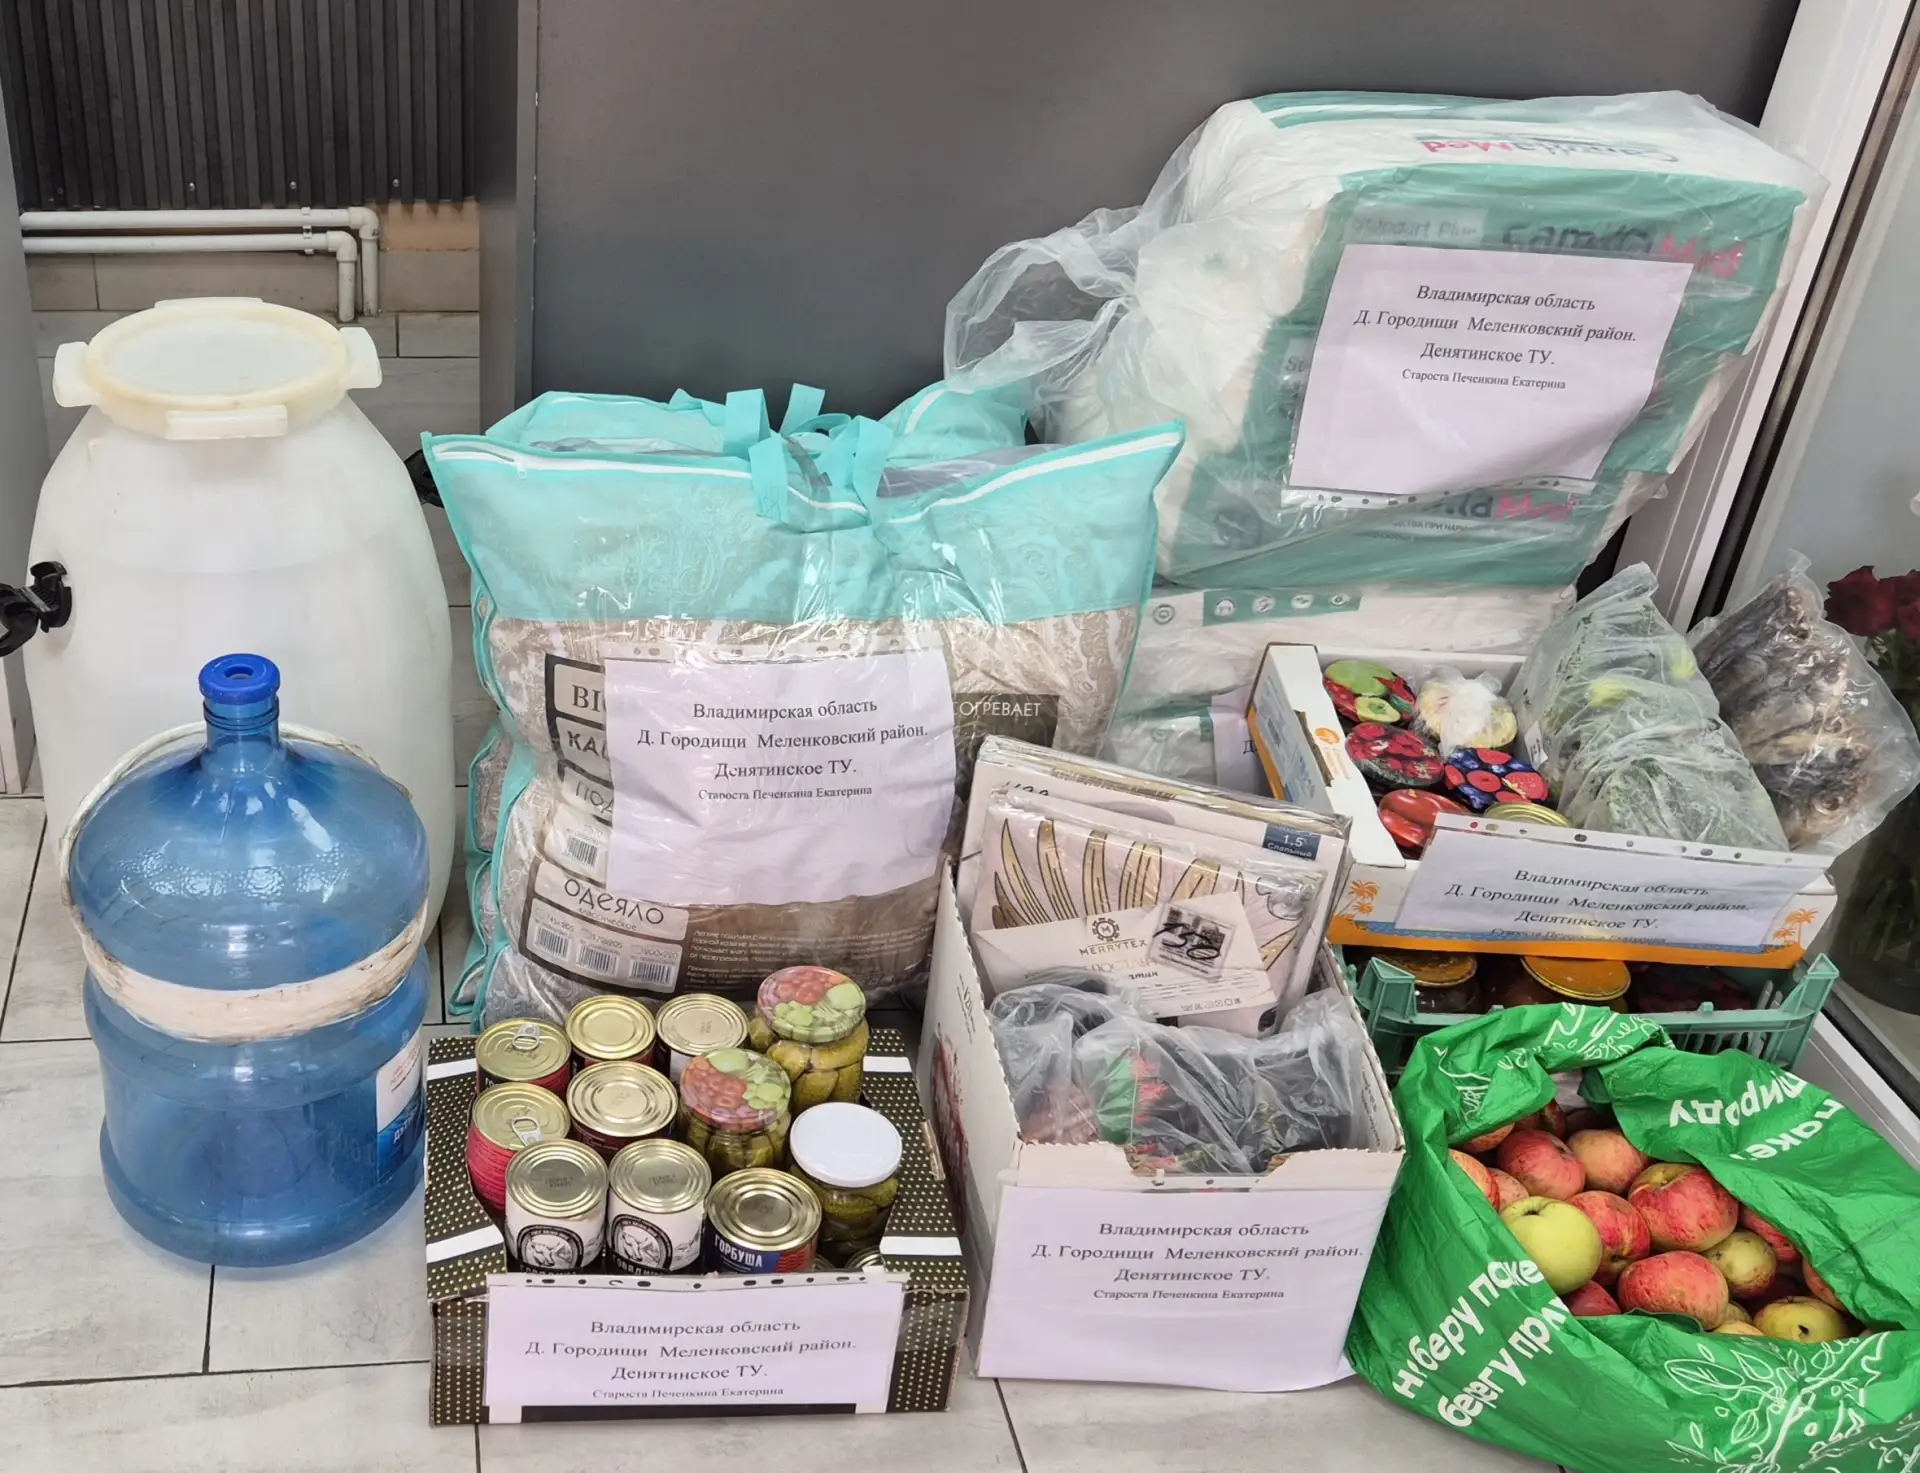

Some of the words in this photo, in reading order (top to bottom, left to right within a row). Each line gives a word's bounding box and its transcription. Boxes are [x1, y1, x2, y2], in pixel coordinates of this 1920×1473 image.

[1416, 285, 1530, 307] Владимирская
[1534, 294, 1596, 311] область
[1353, 310, 1371, 326] Д.
[1376, 311, 1458, 330] Городищи
[1467, 317, 1583, 338] Меленковский
[1584, 328, 1637, 343] район.
[1420, 342, 1522, 363] Денятинское
[1528, 349, 1555, 365] ТУ.
[1402, 369, 1449, 382] Староста
[1452, 373, 1509, 386] Печенкина
[1511, 376, 1566, 390] Екатерина
[692, 703, 812, 722] Владимирская
[818, 699, 877, 717] область
[637, 729, 654, 746] Д.
[660, 731, 746, 751] Городищи
[757, 729, 875, 748] Меленковский
[880, 724, 927, 744] район.
[714, 762, 823, 779] Денятинское
[828, 759, 857, 775] ТУ.
[699, 789, 749, 801] Староста
[753, 788, 813, 800] Печенкина
[816, 785, 872, 798] Екатерина
[1514, 870, 1640, 894] Владимирская
[1644, 884, 1709, 896] область
[1444, 884, 1464, 897] Д.
[1470, 886, 1559, 905] Городищи
[1569, 898, 1693, 912] Меленковский
[1696, 901, 1750, 912] район.
[1514, 910, 1626, 929] Денятинское
[1632, 918, 1659, 929] ТУ.
[1079, 940, 1148, 956] MERRYTEX
[1099, 1223, 1232, 1238] Владимирская
[1238, 1223, 1309, 1236] область
[715, 1233, 763, 1268] ГОРБУША
[1031, 1245, 1052, 1258] Д.
[1058, 1246, 1154, 1260] Городищи
[1165, 1245, 1299, 1260] Меленковский
[1303, 1246, 1363, 1260] район.
[1114, 1268, 1233, 1283] Денятинское
[1240, 1268, 1271, 1281] ТУ.
[1094, 1290, 1148, 1300] Староста
[1152, 1290, 1218, 1300] Печенкина
[1222, 1290, 1285, 1300] Екатерина
[591, 1321, 724, 1338] Владимирская
[730, 1320, 800, 1334] область
[1409, 1296, 1484, 1371] беру
[524, 1341, 545, 1356] Д.
[552, 1343, 648, 1359] Городищи
[660, 1340, 793, 1358] Меленковский
[799, 1339, 856, 1354] район.
[611, 1367, 730, 1381] Денятинское
[736, 1364, 768, 1378] ТУ.
